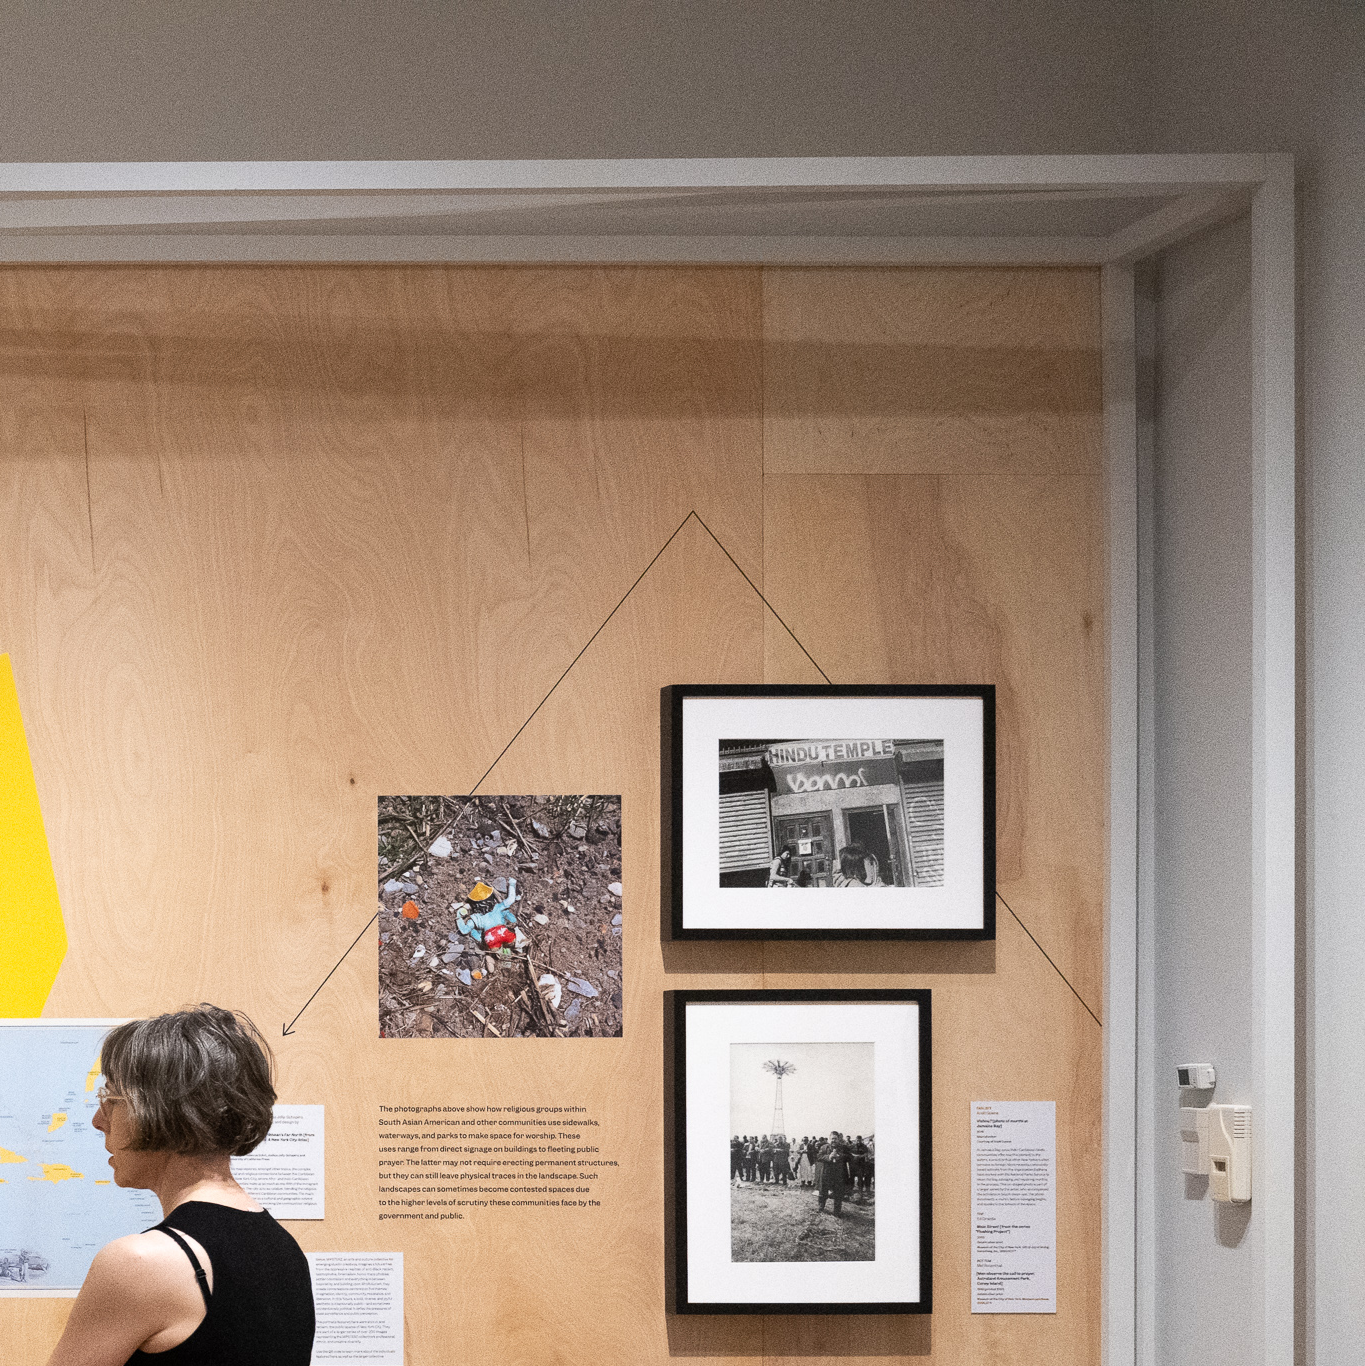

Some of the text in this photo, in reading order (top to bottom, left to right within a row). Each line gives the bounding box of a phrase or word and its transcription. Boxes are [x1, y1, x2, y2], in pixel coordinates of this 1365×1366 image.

[770, 746, 819, 765] HINDU
[823, 741, 893, 760] TEMPLE
[504, 1146, 537, 1154] buildings
[547, 1146, 575, 1154] fleeting
[502, 1159, 533, 1167] erecting
[401, 1199, 425, 1207] higher
